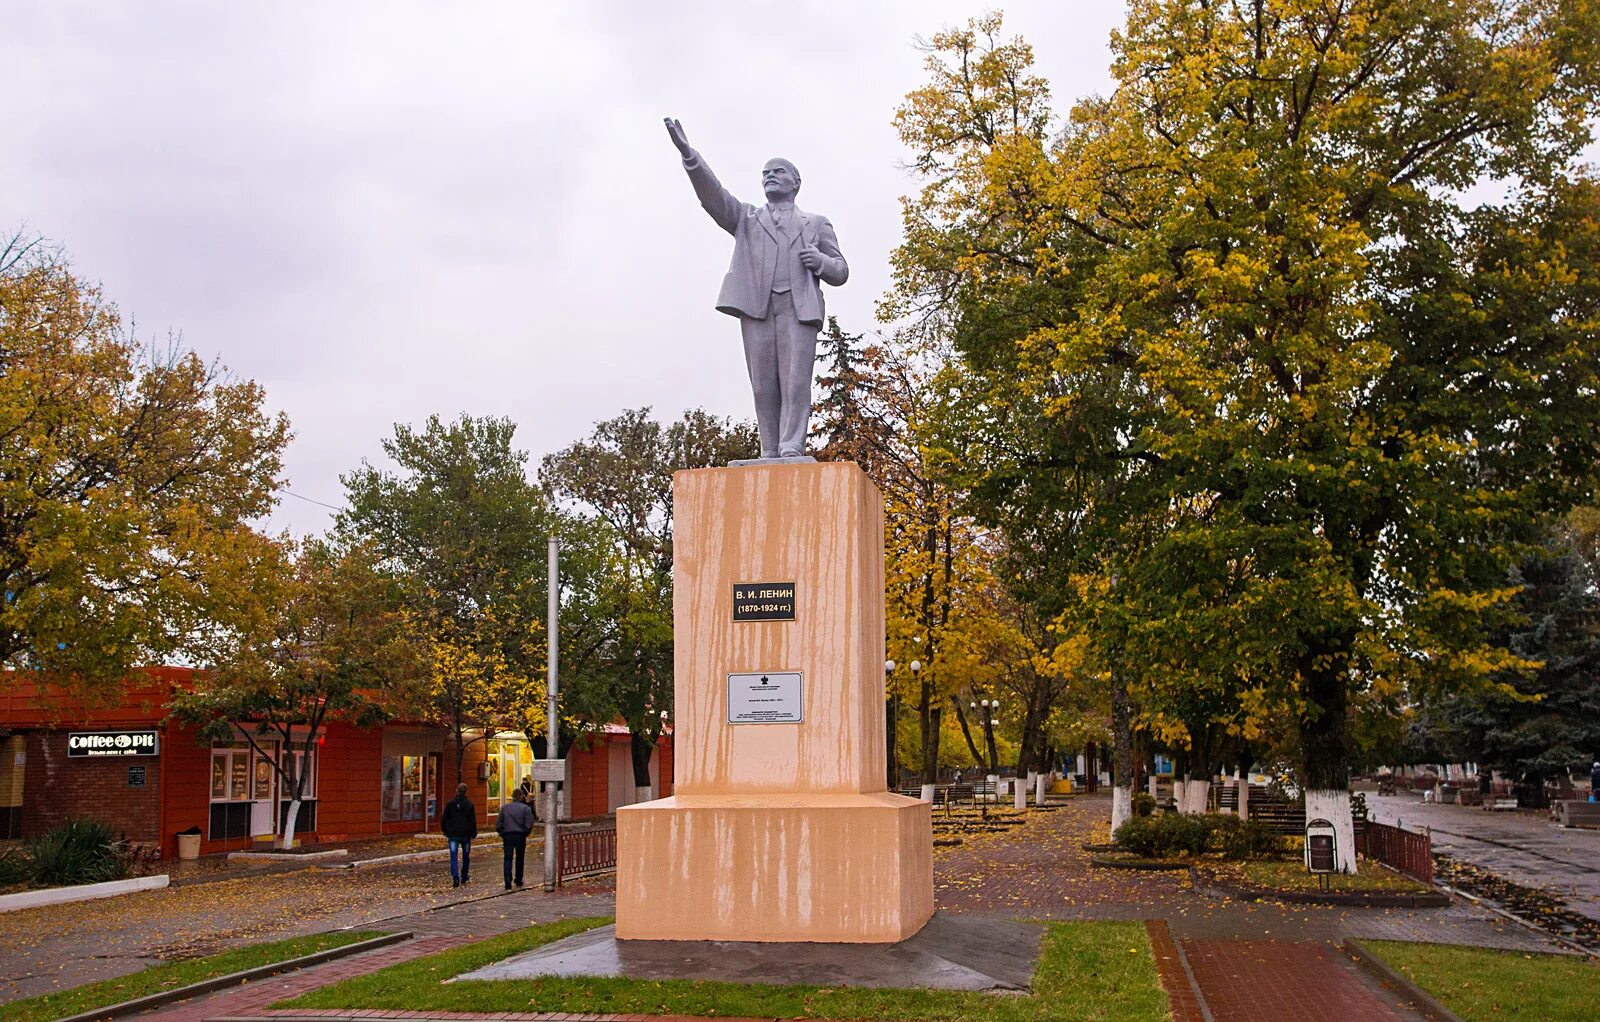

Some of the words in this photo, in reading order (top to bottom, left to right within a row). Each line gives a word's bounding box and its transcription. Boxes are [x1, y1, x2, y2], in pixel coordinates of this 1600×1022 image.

[736, 591, 746, 599] В.
[747, 590, 757, 599] И.
[759, 589, 793, 598] ЛЕНИН
[738, 604, 778, 613] (1870-1924
[779, 604, 791, 612] гг.)
[69, 735, 114, 749] Coffee
